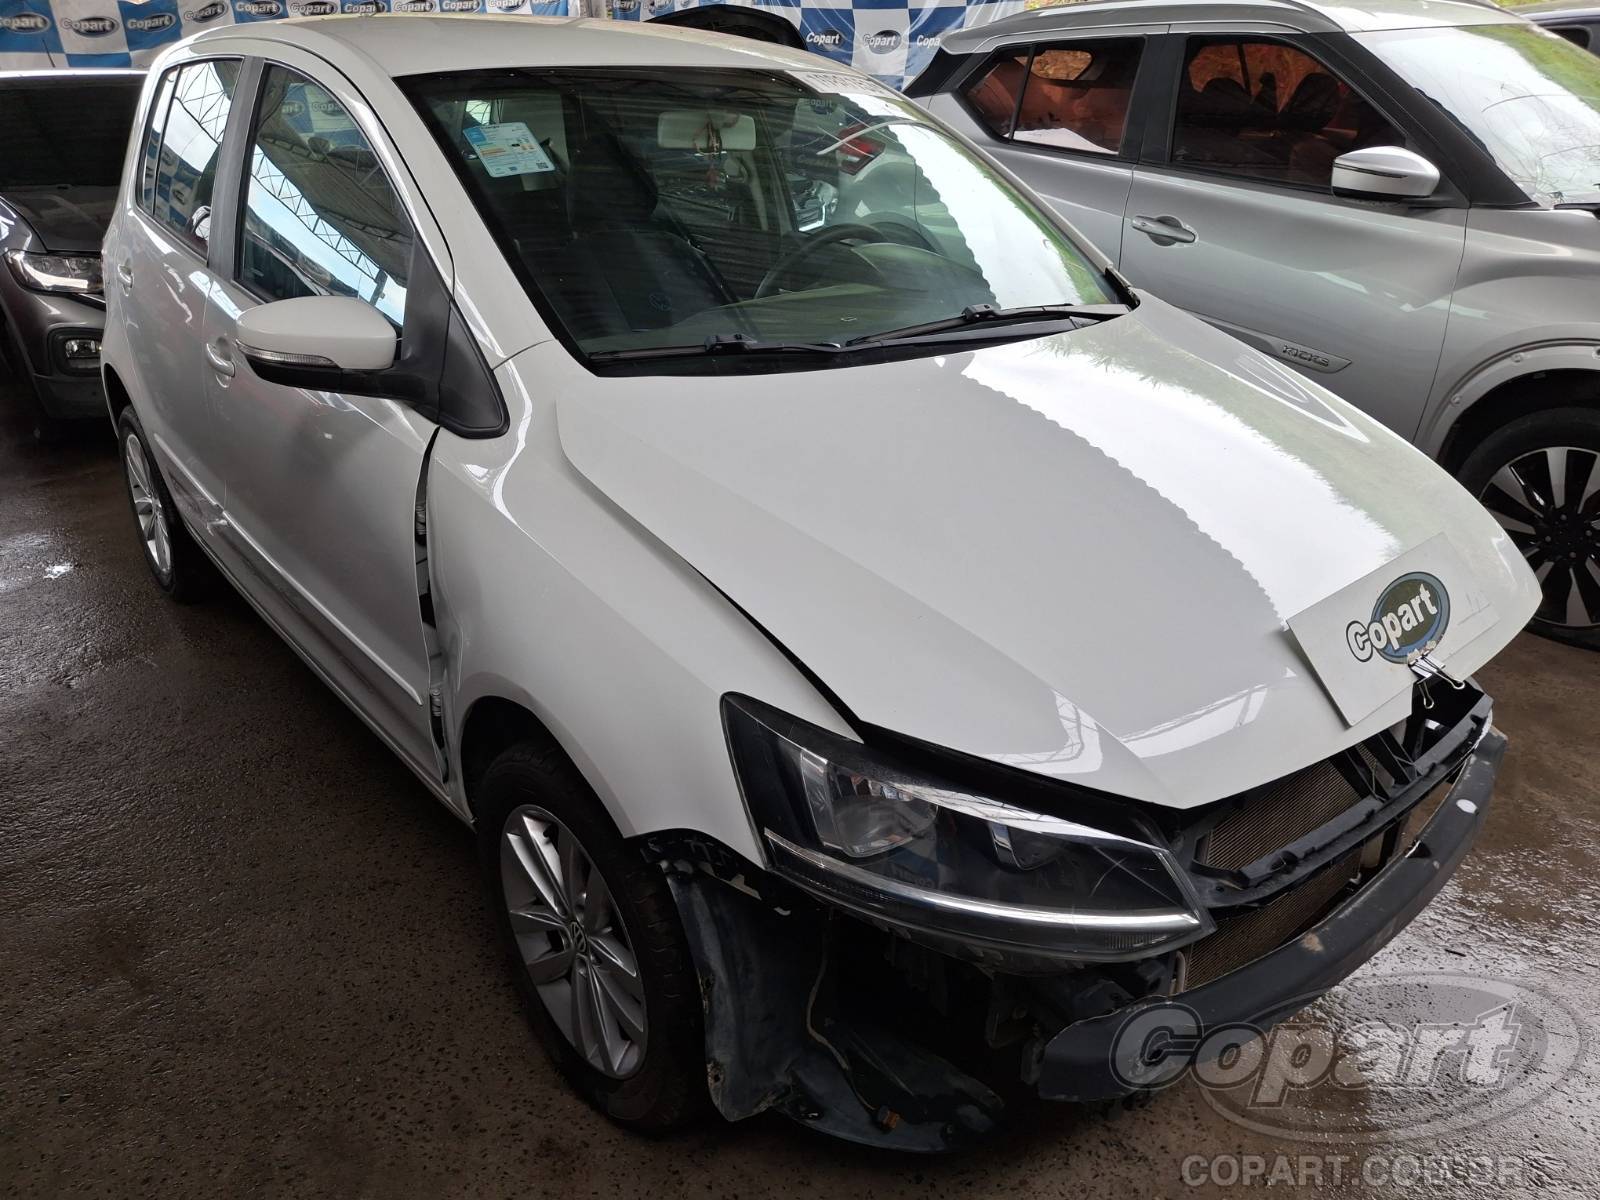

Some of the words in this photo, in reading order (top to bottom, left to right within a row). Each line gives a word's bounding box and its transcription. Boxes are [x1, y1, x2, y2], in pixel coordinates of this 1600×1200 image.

[235, 2, 277, 14] Copart
[289, 3, 331, 15] Copart
[442, 0, 477, 10] Copart
[61, 18, 113, 32] Copart
[127, 16, 170, 30] Copart
[806, 32, 840, 44] Copart
[863, 34, 897, 47] Copart
[916, 35, 941, 47] Copa
[1346, 584, 1438, 662] Copart
